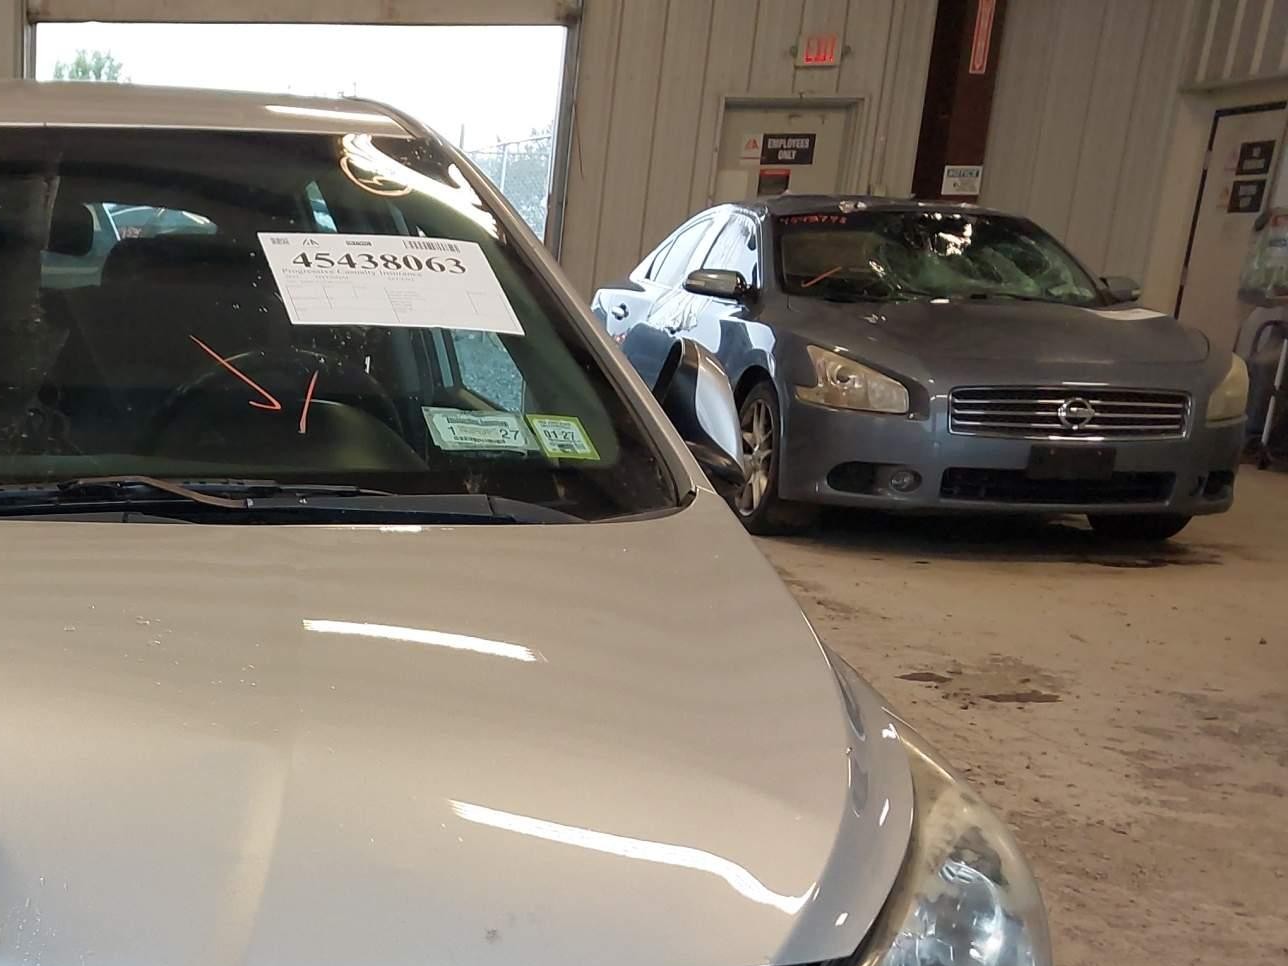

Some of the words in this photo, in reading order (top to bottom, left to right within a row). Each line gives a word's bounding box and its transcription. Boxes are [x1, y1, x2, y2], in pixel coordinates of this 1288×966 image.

[767, 138, 810, 149] EMPLOYEES
[777, 149, 797, 161] ONLY
[292, 251, 467, 274] 45438063
[499, 429, 520, 442] 27
